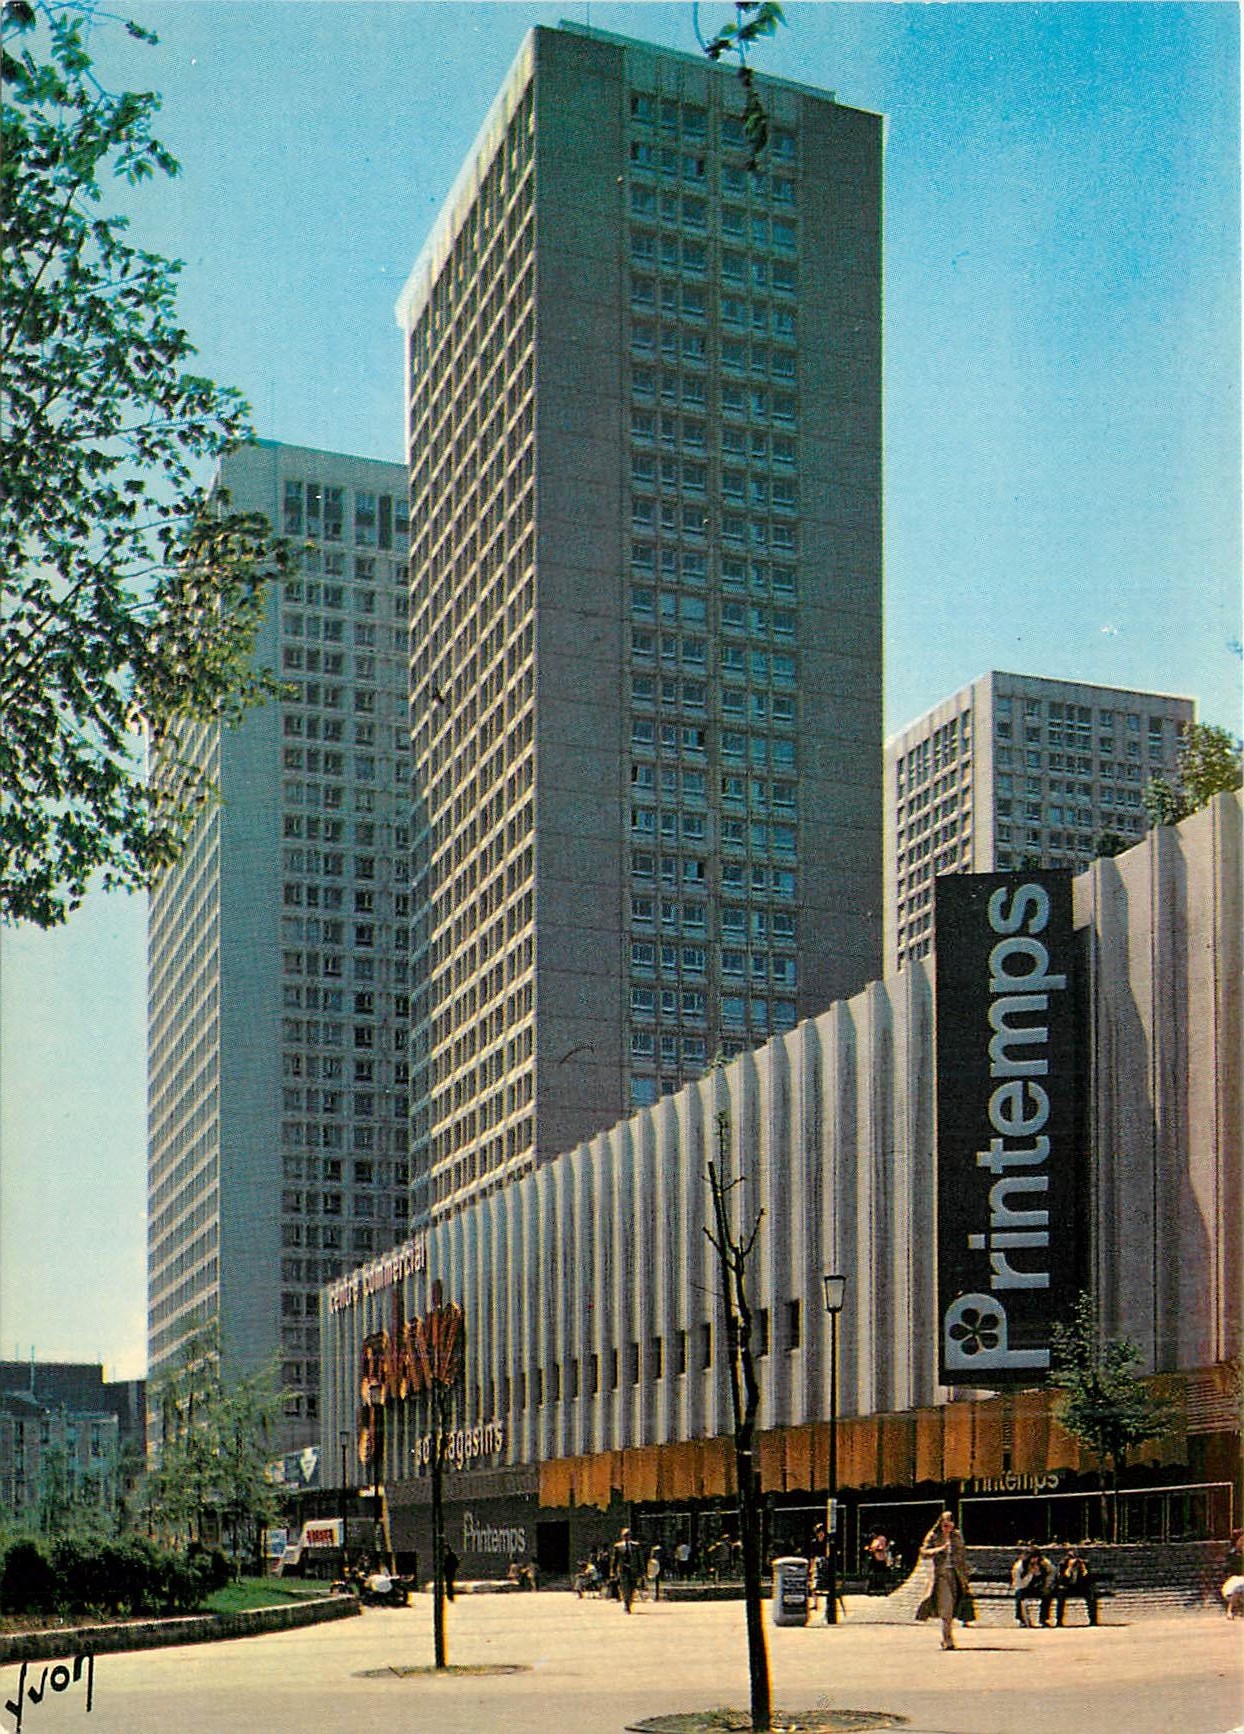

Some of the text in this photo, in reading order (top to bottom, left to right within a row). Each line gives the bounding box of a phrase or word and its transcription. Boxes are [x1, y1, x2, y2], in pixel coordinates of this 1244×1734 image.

[944, 881, 1067, 1371] Printemps
[440, 1420, 503, 1470] agasins
[464, 1511, 527, 1560] Printemps
